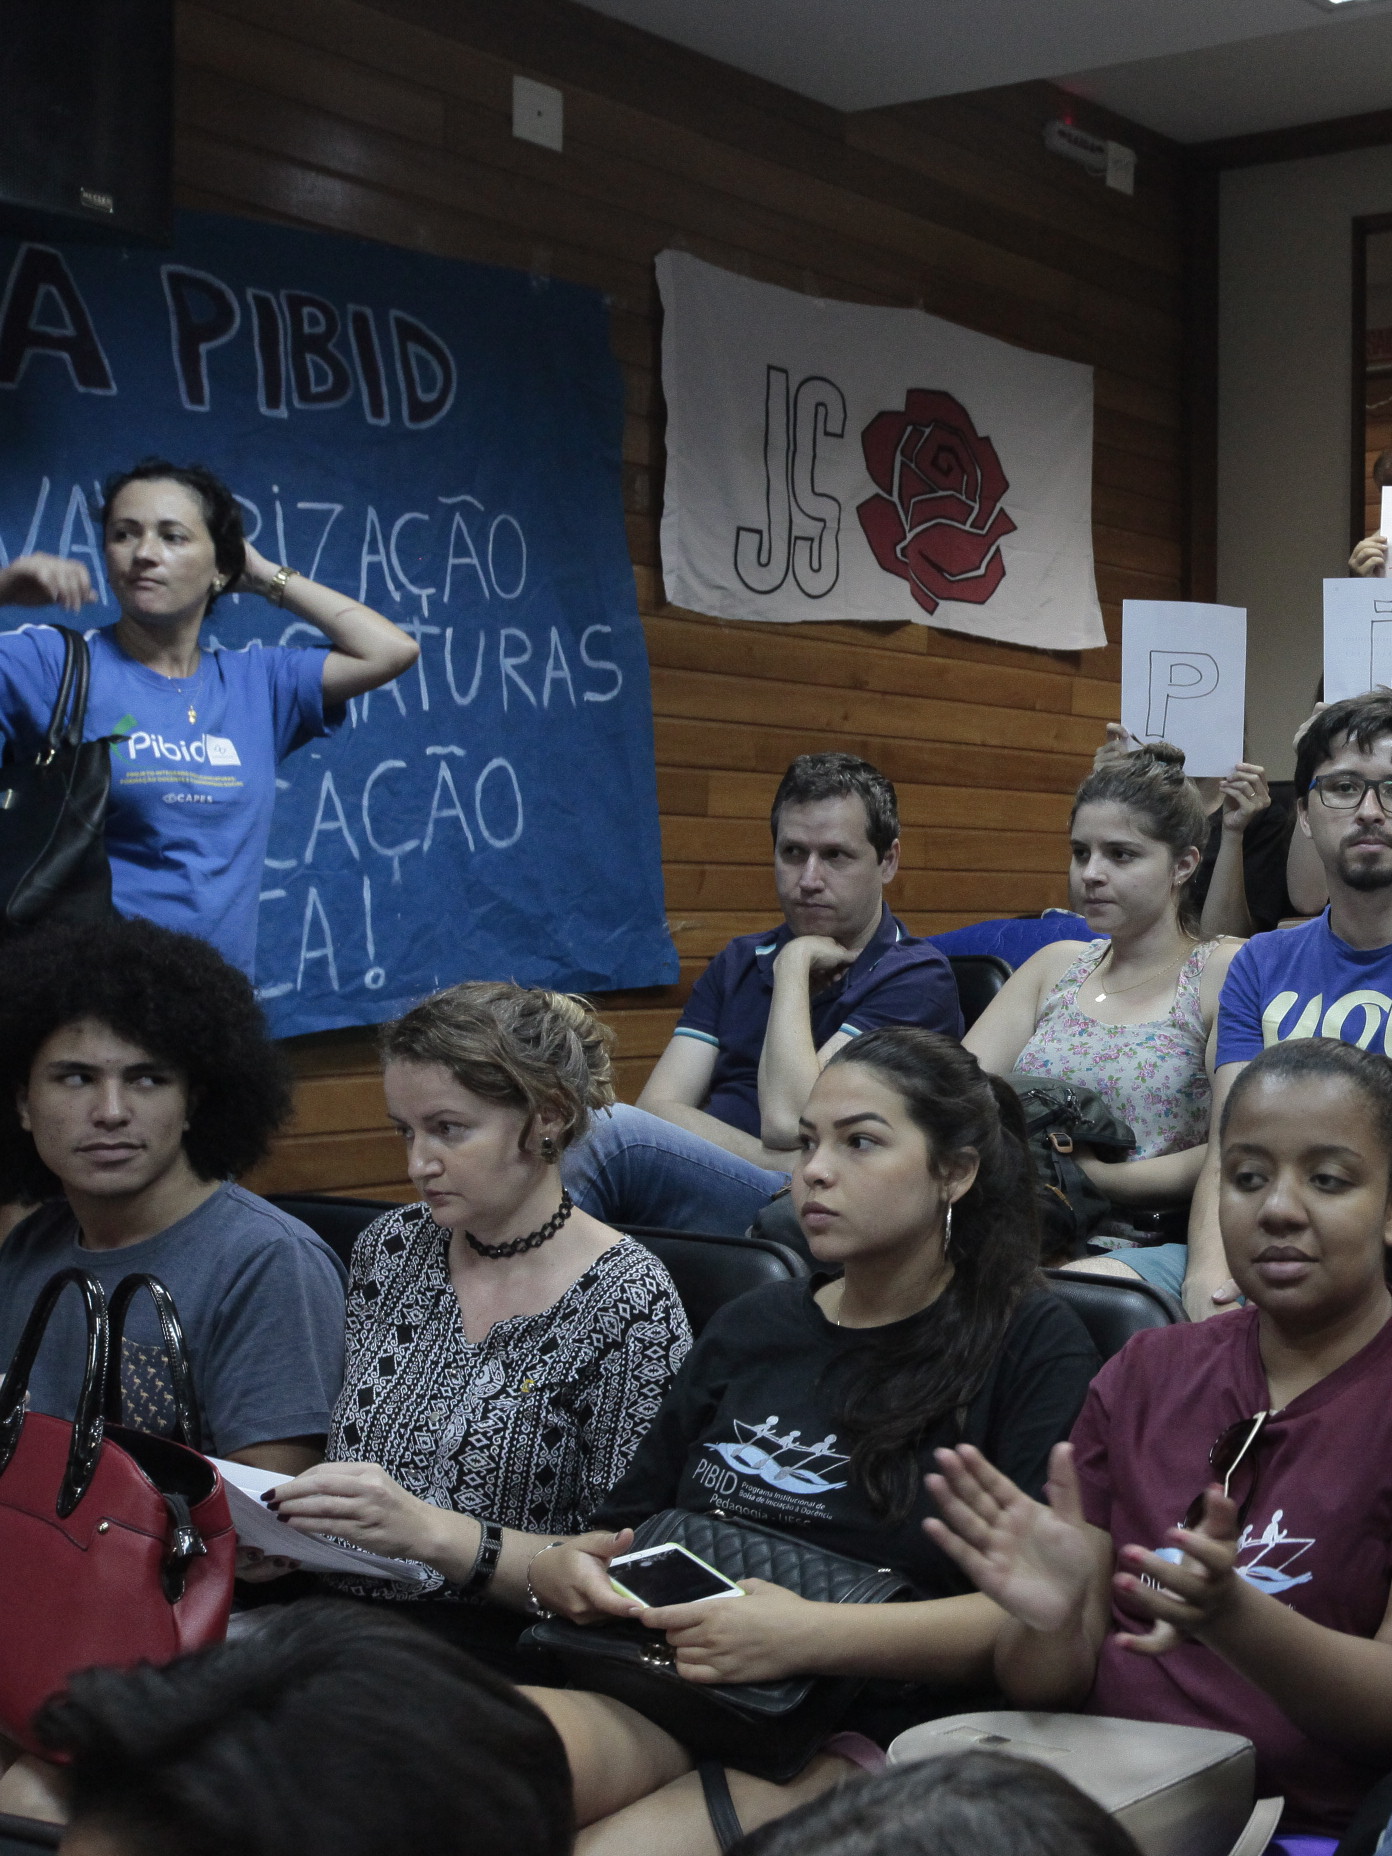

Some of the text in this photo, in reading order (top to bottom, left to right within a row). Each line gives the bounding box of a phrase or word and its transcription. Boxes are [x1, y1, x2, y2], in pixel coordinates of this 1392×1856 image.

[160, 264, 457, 429] PIBID
[734, 364, 848, 600] JS
[1145, 650, 1220, 738] P
[128, 731, 206, 763] Pibid
[177, 793, 214, 804] CAPES
[692, 1458, 738, 1495] PIBID
[709, 1493, 768, 1520] Pedagogia
[739, 1489, 756, 1501] Bolsa
[756, 1496, 765, 1504] de
[800, 1506, 834, 1520] Docência
[741, 1481, 826, 1510] Programa Institucional de
